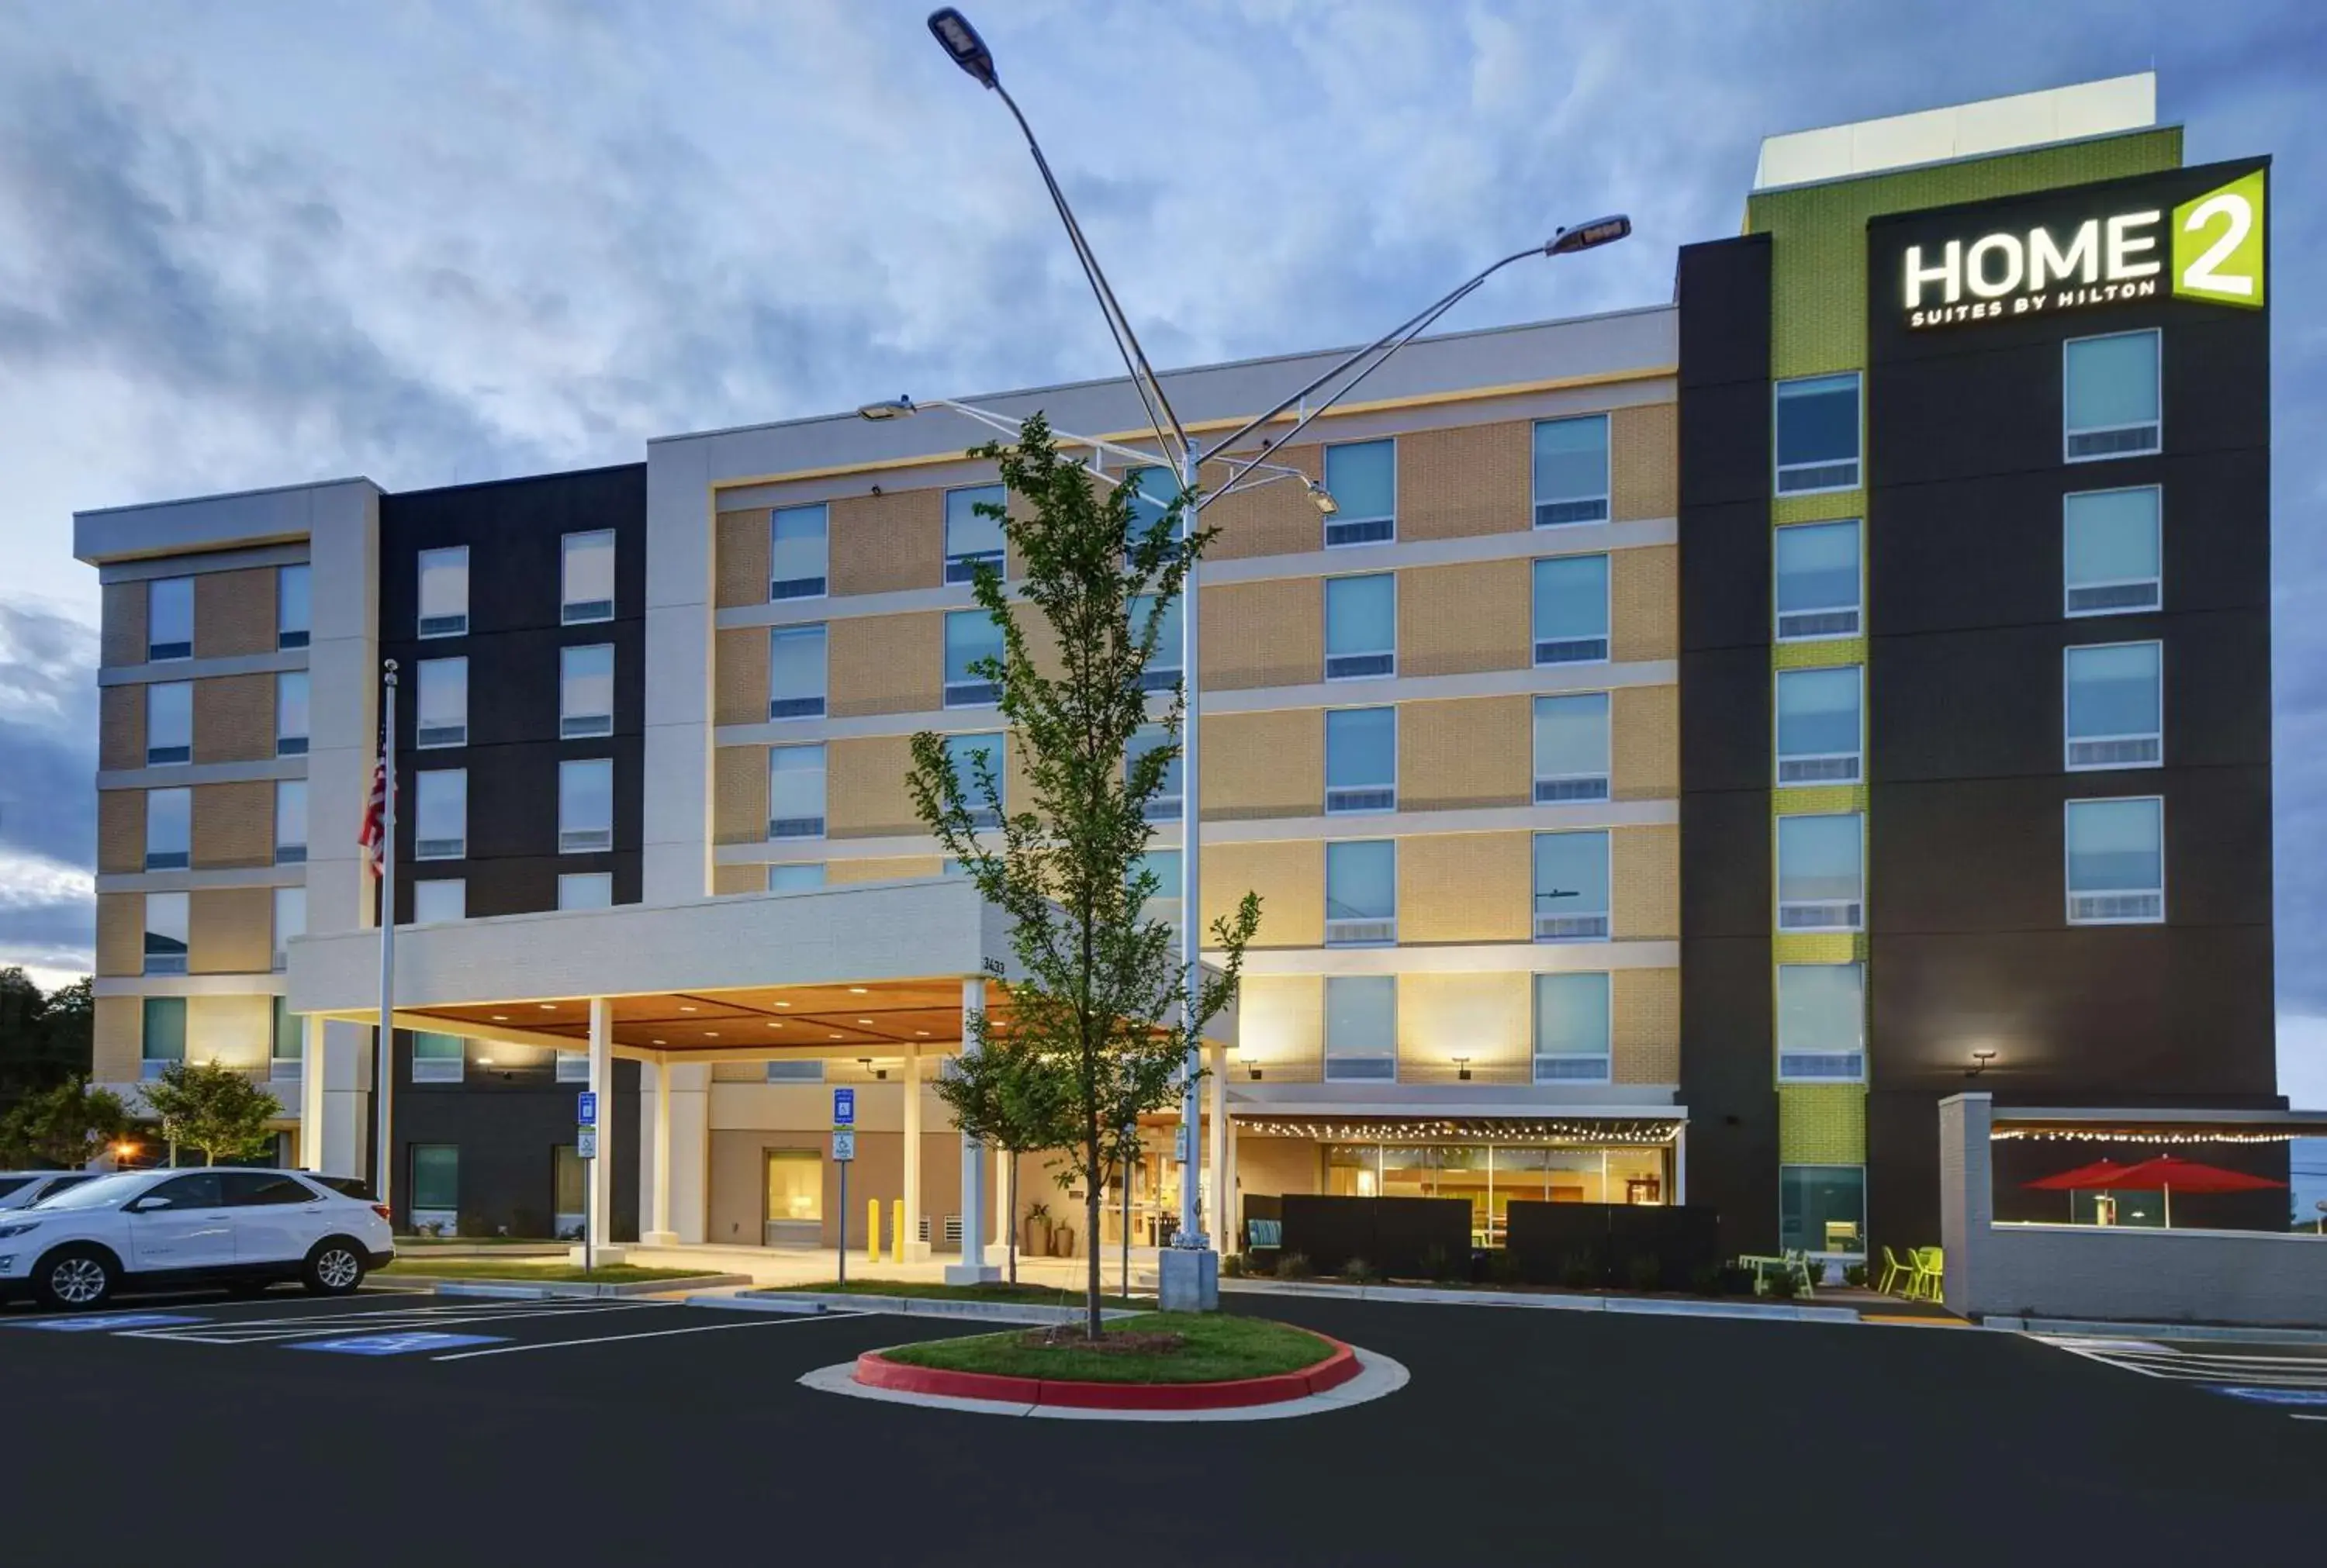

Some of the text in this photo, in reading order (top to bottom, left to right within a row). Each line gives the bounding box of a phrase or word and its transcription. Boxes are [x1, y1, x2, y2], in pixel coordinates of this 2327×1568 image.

[1904, 193, 2253, 309] HOME 2
[1910, 279, 2156, 327] SUITES BY HILTON
